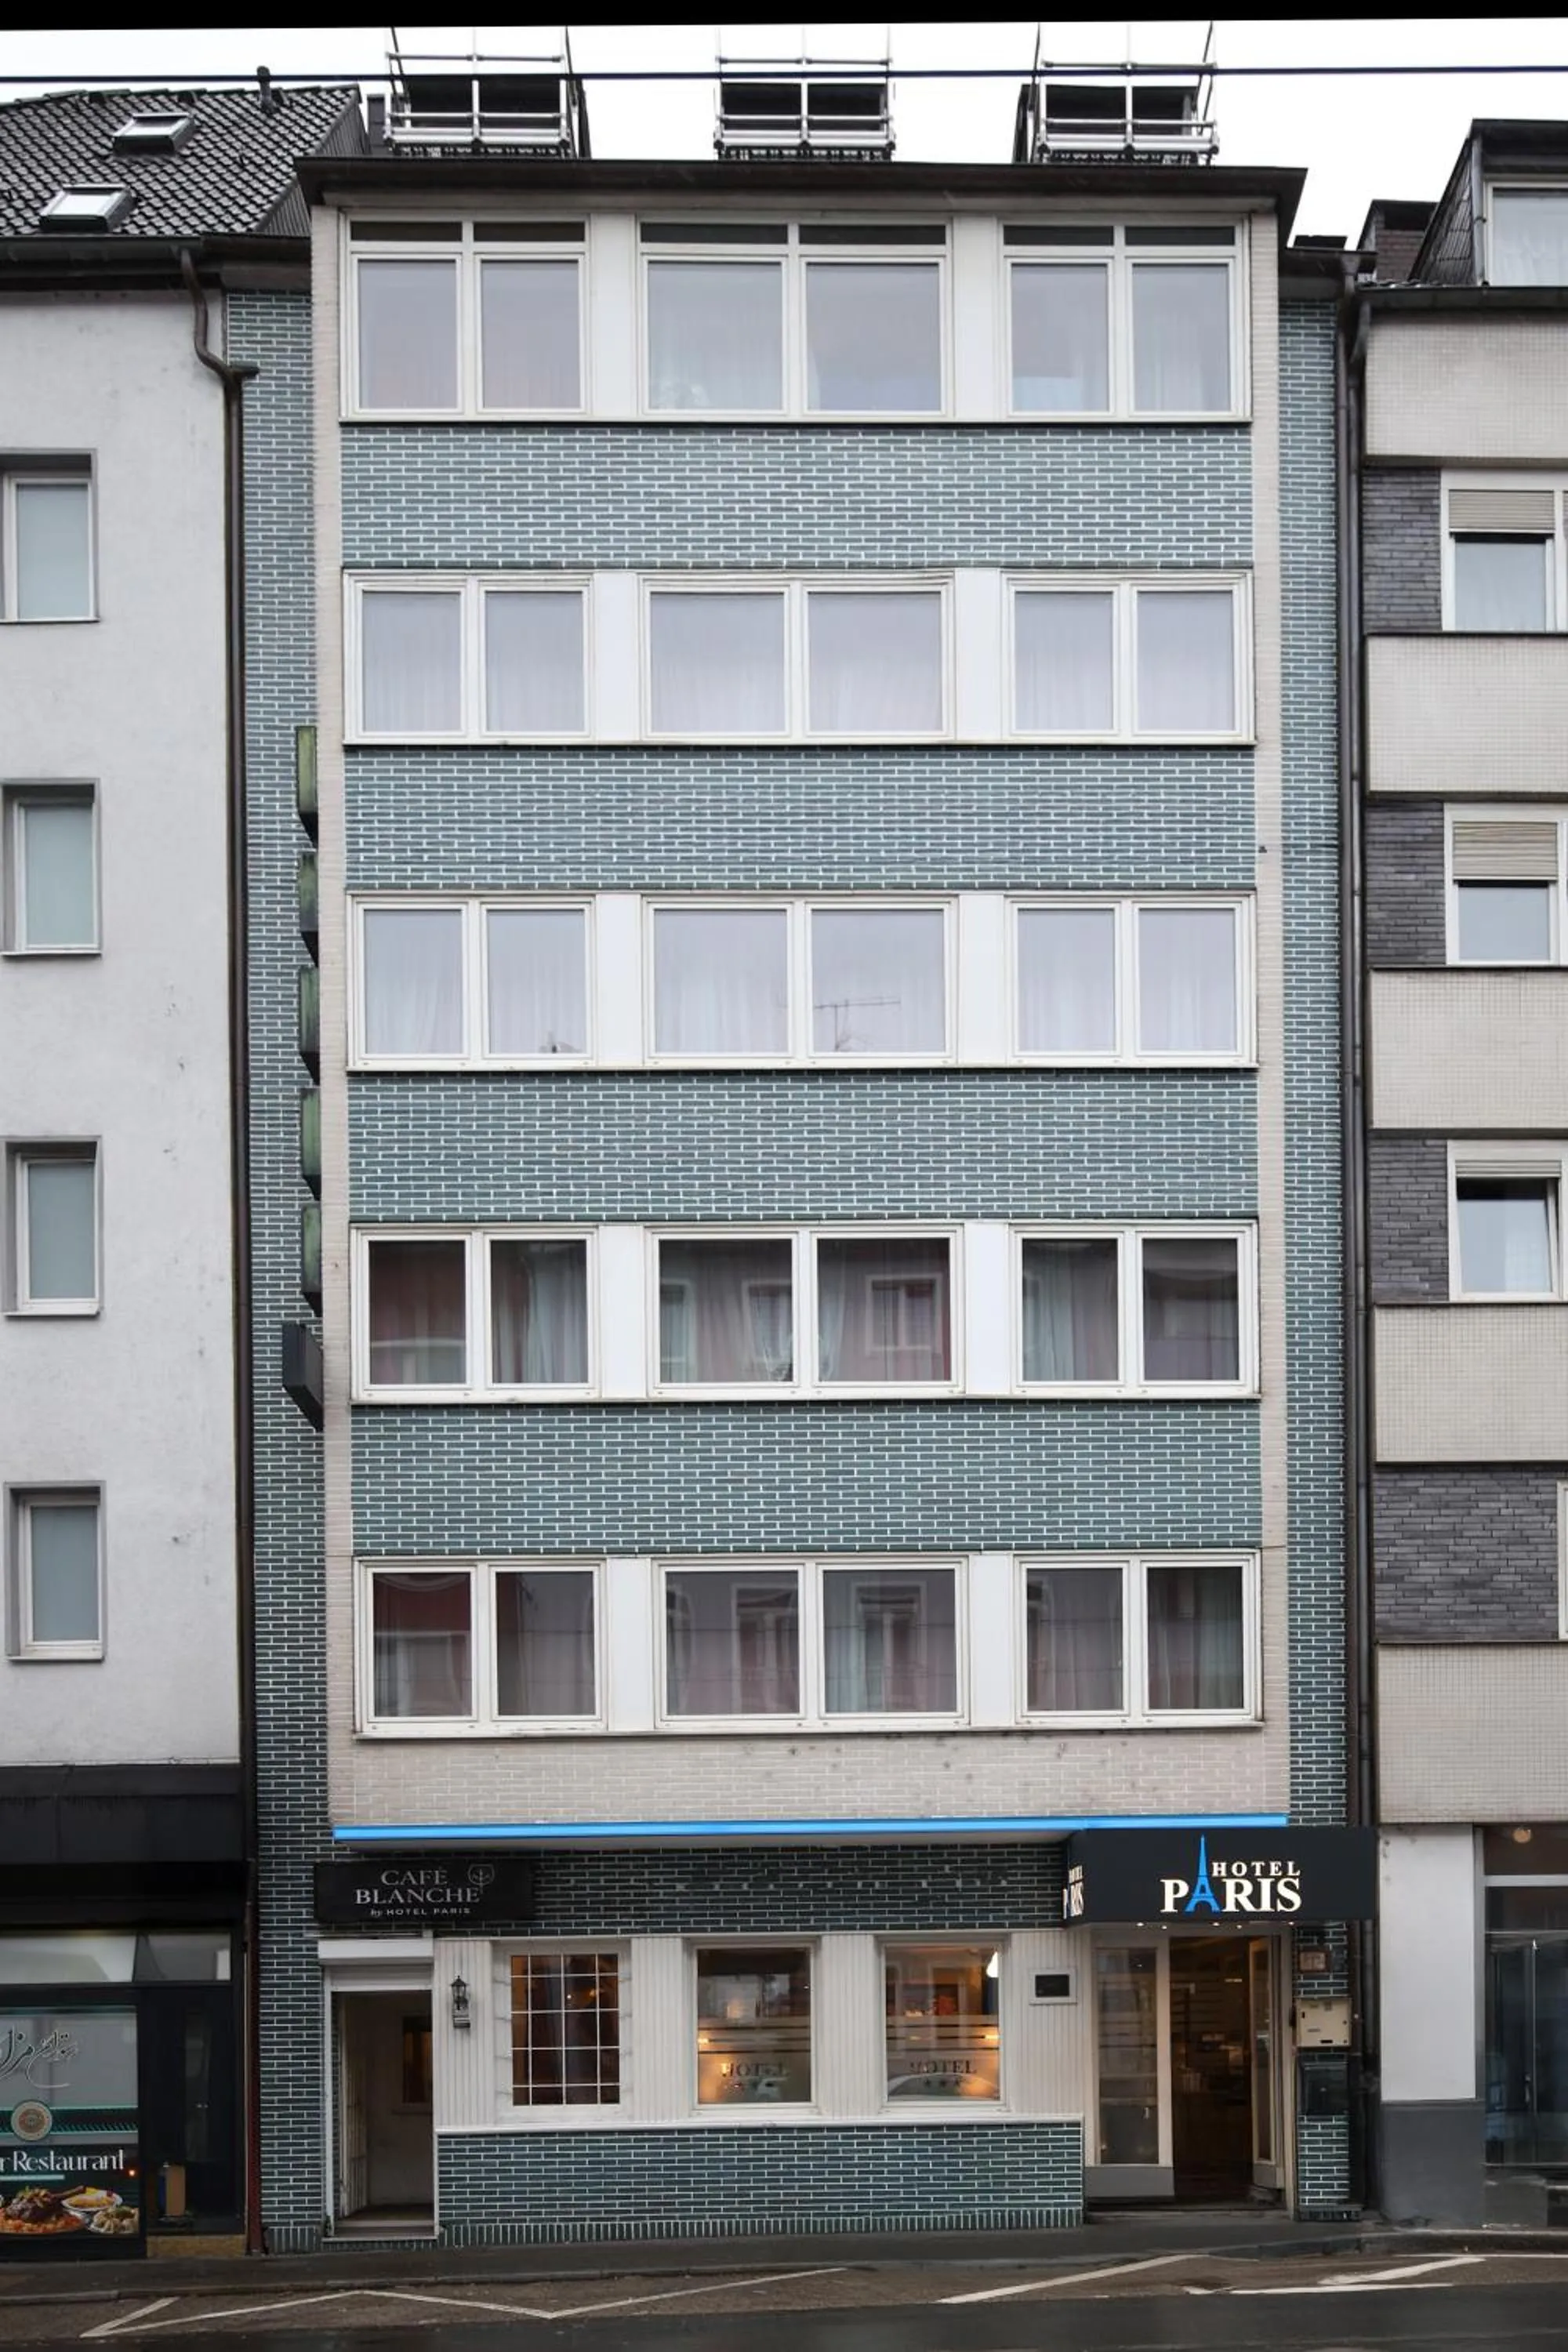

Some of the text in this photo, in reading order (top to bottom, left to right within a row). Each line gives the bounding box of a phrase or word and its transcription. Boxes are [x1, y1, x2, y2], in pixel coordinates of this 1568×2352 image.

[380, 1866, 448, 1886] CAFÉ
[1211, 1861, 1301, 1877] HOTEL
[355, 1887, 481, 1904] BLANCHE
[370, 1908, 383, 1918] by
[13, 2149, 125, 2171] Restaurant
